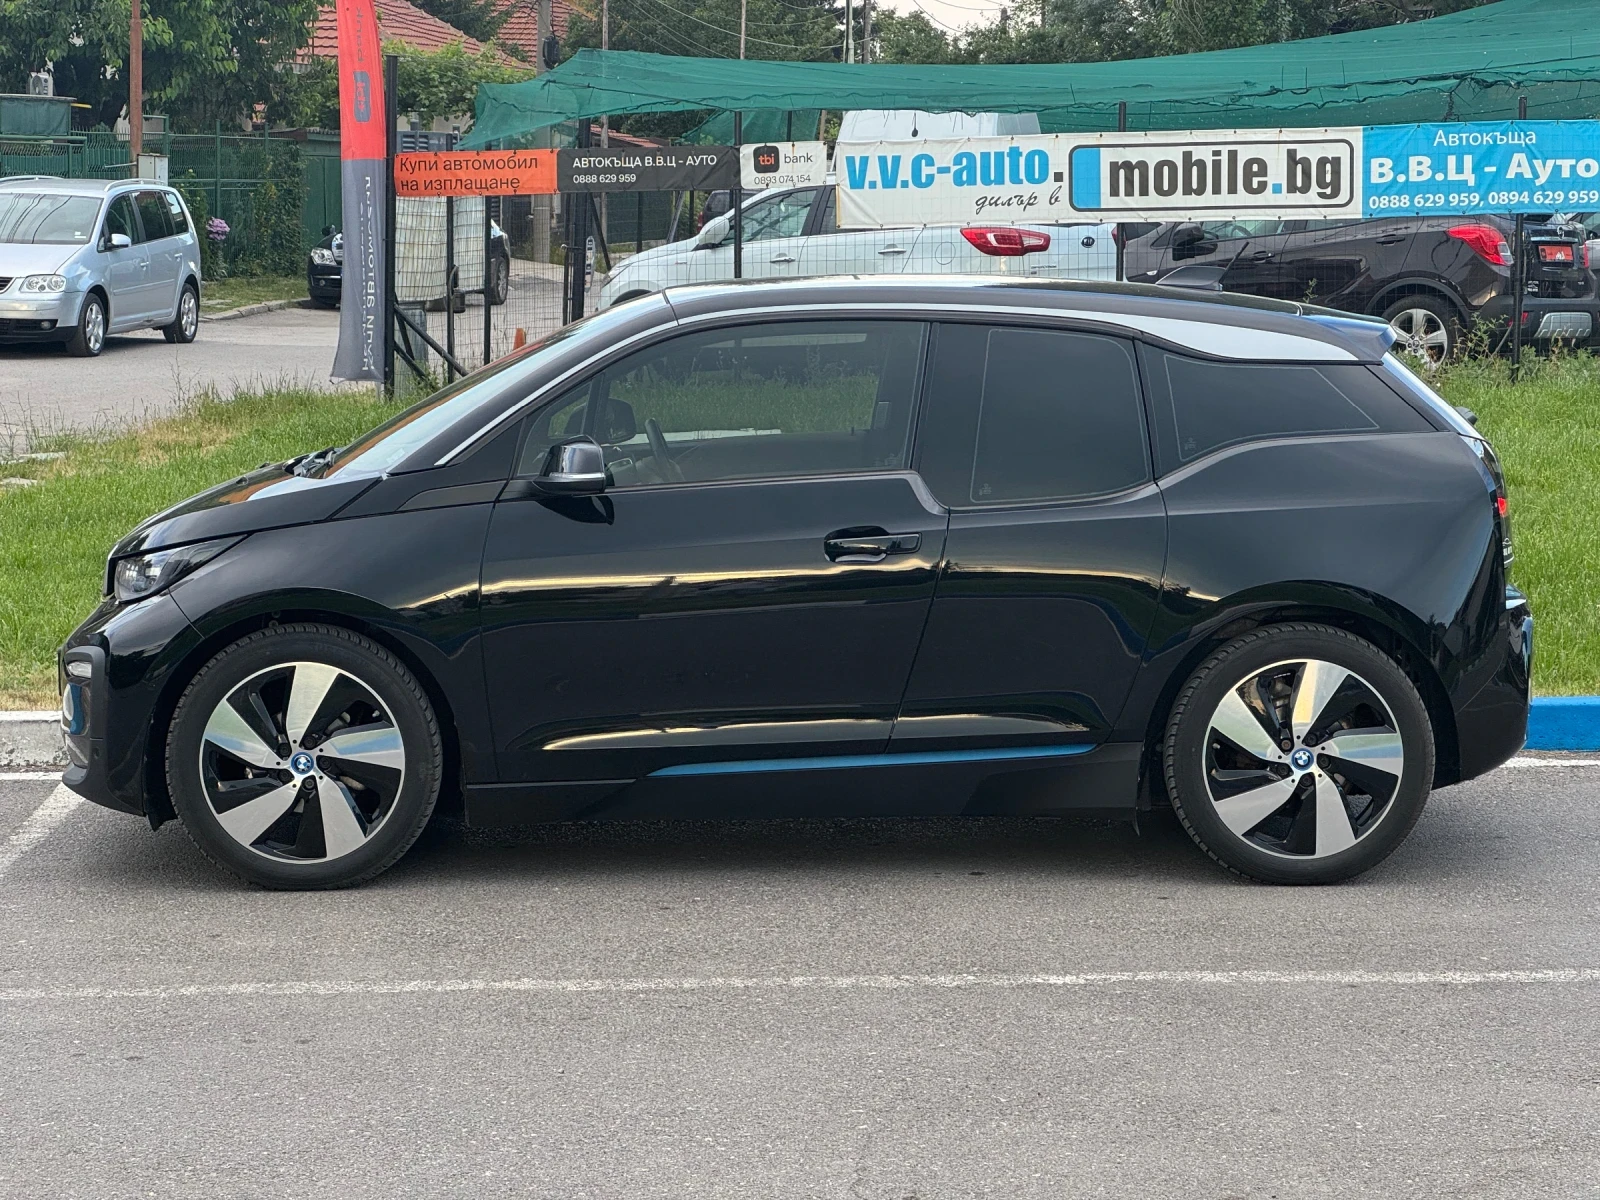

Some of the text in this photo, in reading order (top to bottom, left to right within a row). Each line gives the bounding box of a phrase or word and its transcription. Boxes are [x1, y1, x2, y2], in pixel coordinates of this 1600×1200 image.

[1433, 128, 1537, 148] Автокъща
[400, 155, 538, 174] Купи автомобил
[573, 156, 642, 168] АВТОКЪЩА
[645, 155, 676, 168] В.В.Ц
[686, 154, 718, 166] АУТО
[758, 152, 813, 165] tbi bank
[573, 173, 636, 183] 0888 629 959
[1109, 148, 1342, 199] mobile.bg
[1370, 154, 1475, 186] В.В.Ц
[1505, 152, 1599, 186] Ауто
[401, 177, 520, 194] на изплащане
[754, 174, 811, 185] 0893 074 154
[1369, 189, 1599, 208] 0888 629 959, 0894 629 959
